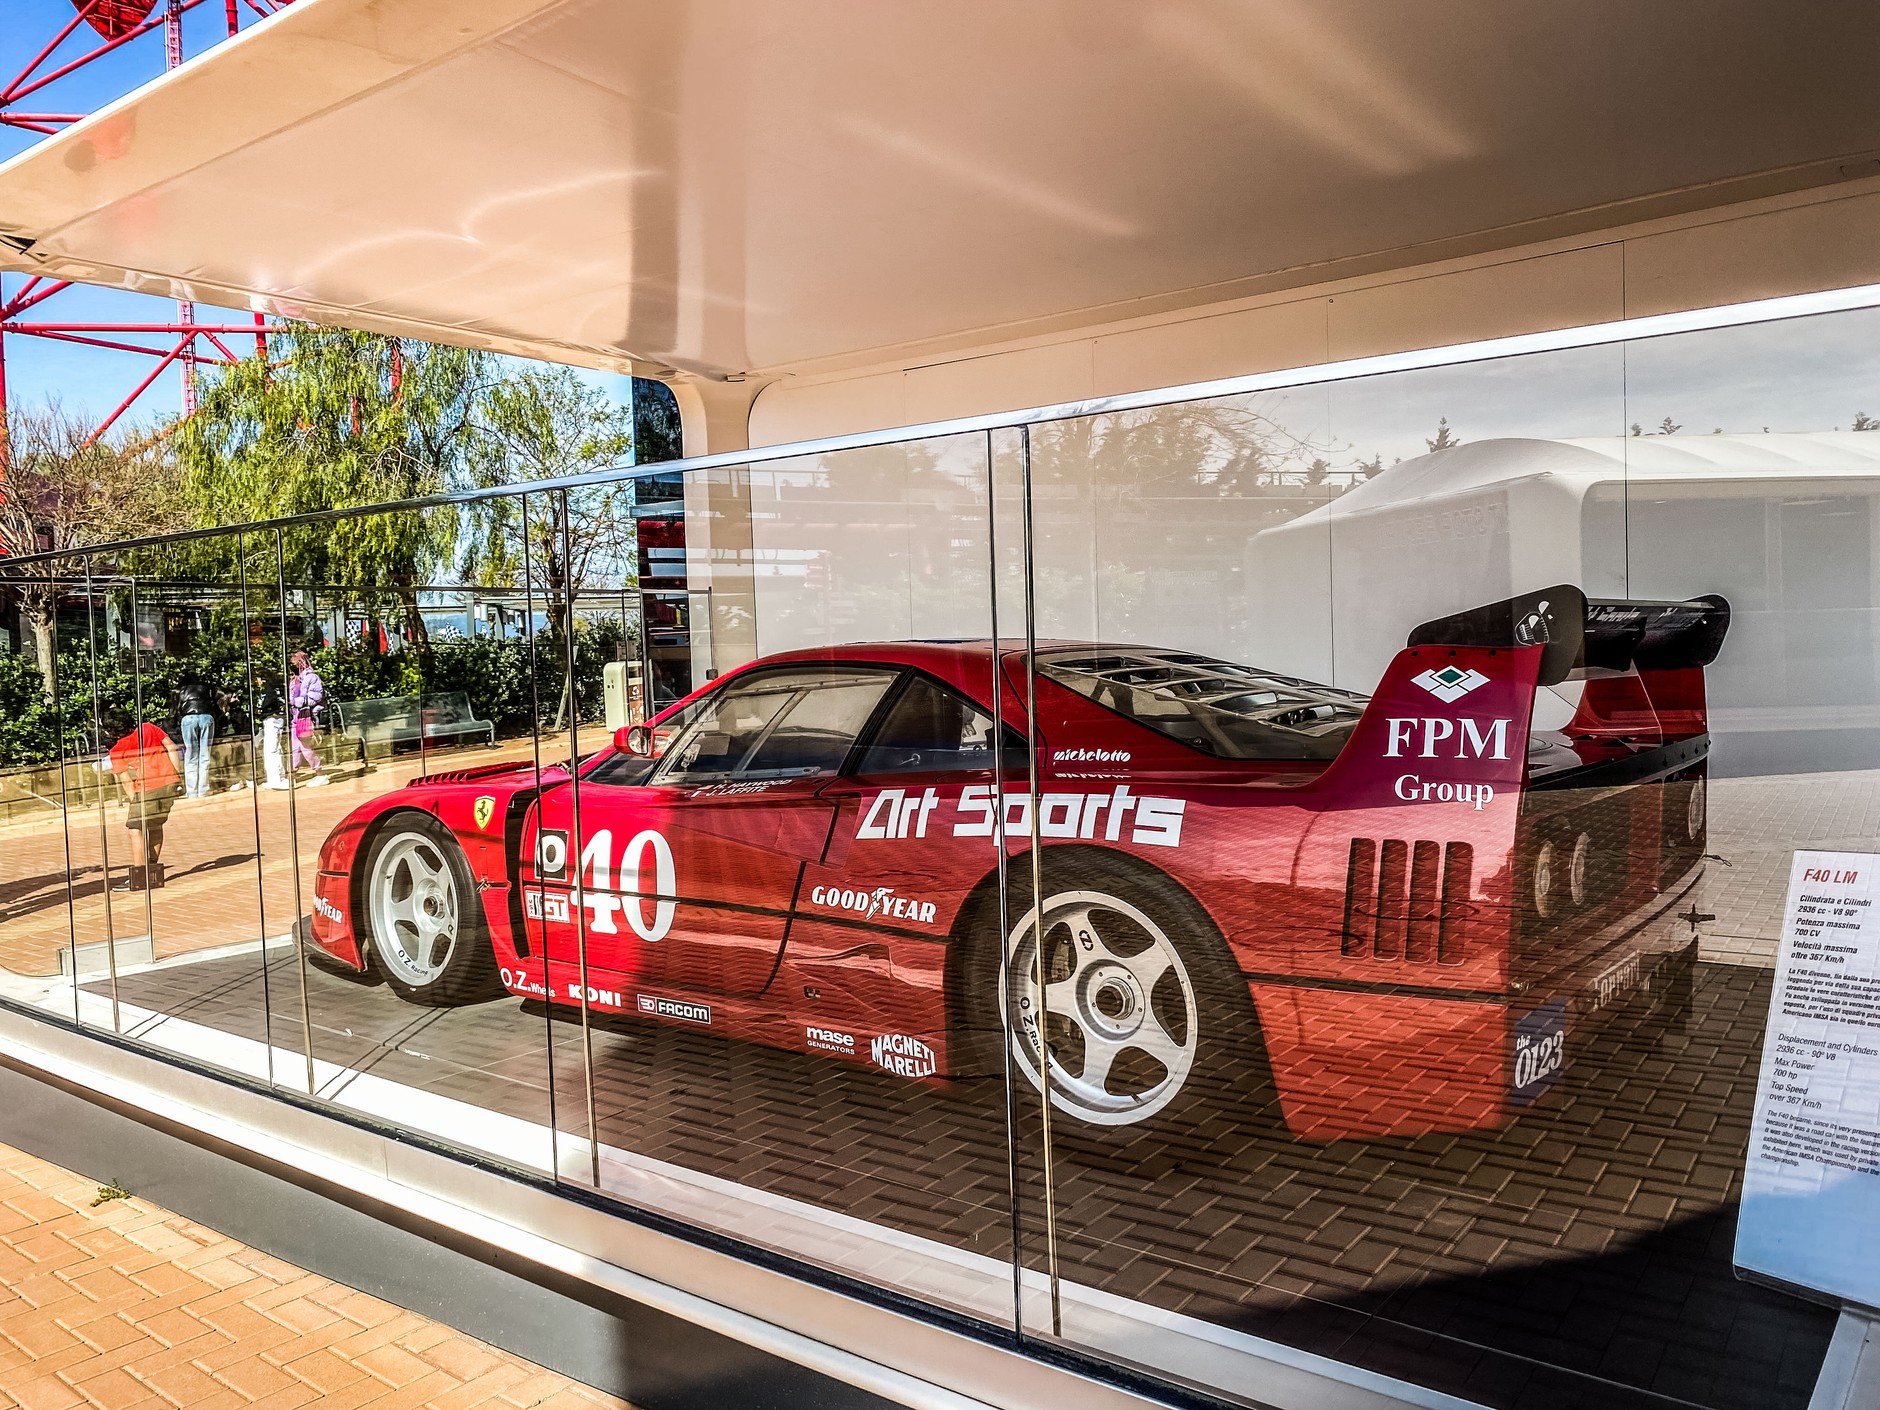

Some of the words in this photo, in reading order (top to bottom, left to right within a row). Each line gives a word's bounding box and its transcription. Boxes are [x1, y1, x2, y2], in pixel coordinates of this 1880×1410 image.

[1382, 718, 1513, 760] FPM
[1053, 748, 1131, 762] michelotto
[1394, 774, 1495, 811] Group
[855, 787, 940, 840] Art
[953, 785, 1187, 848] Sports
[1803, 868, 1831, 882] F40
[1833, 870, 1858, 884] LM
[570, 829, 677, 942] 40
[1800, 895, 1836, 904] Cilindrata
[1844, 898, 1872, 906] Cilindri
[1798, 906, 1816, 914] 2936
[1796, 918, 1824, 926] Potenza
[1826, 921, 1861, 930] massima
[1793, 940, 1822, 950] Velocità
[1824, 944, 1858, 954] massima
[1790, 952, 1808, 960] oltre
[1825, 954, 1845, 964] Km/h
[568, 983, 622, 1007] KONI
[658, 998, 708, 1020] FACOM
[1782, 1009, 1812, 1018] Americano
[806, 1026, 855, 1047] mase
[1516, 1034, 1531, 1050] the
[1778, 1033, 1826, 1047] Displacement
[1827, 1042, 1842, 1050] and
[1844, 1044, 1878, 1056] Cylinders
[807, 1040, 856, 1056] GENERATORS
[1776, 1044, 1795, 1054] 2936
[1826, 1052, 1836, 1060] V8
[1515, 1030, 1564, 1089] 0123
[1774, 1057, 1790, 1066] Max
[1791, 1060, 1815, 1070] Power
[1773, 1068, 1787, 1077] 700
[1788, 1071, 1798, 1080] hp
[1772, 1081, 1784, 1091] Top
[1785, 1084, 1809, 1095] Speed
[1786, 1096, 1801, 1104] 367
[1802, 1099, 1822, 1109] Km/h
[1815, 1156, 1857, 1171] Championship
